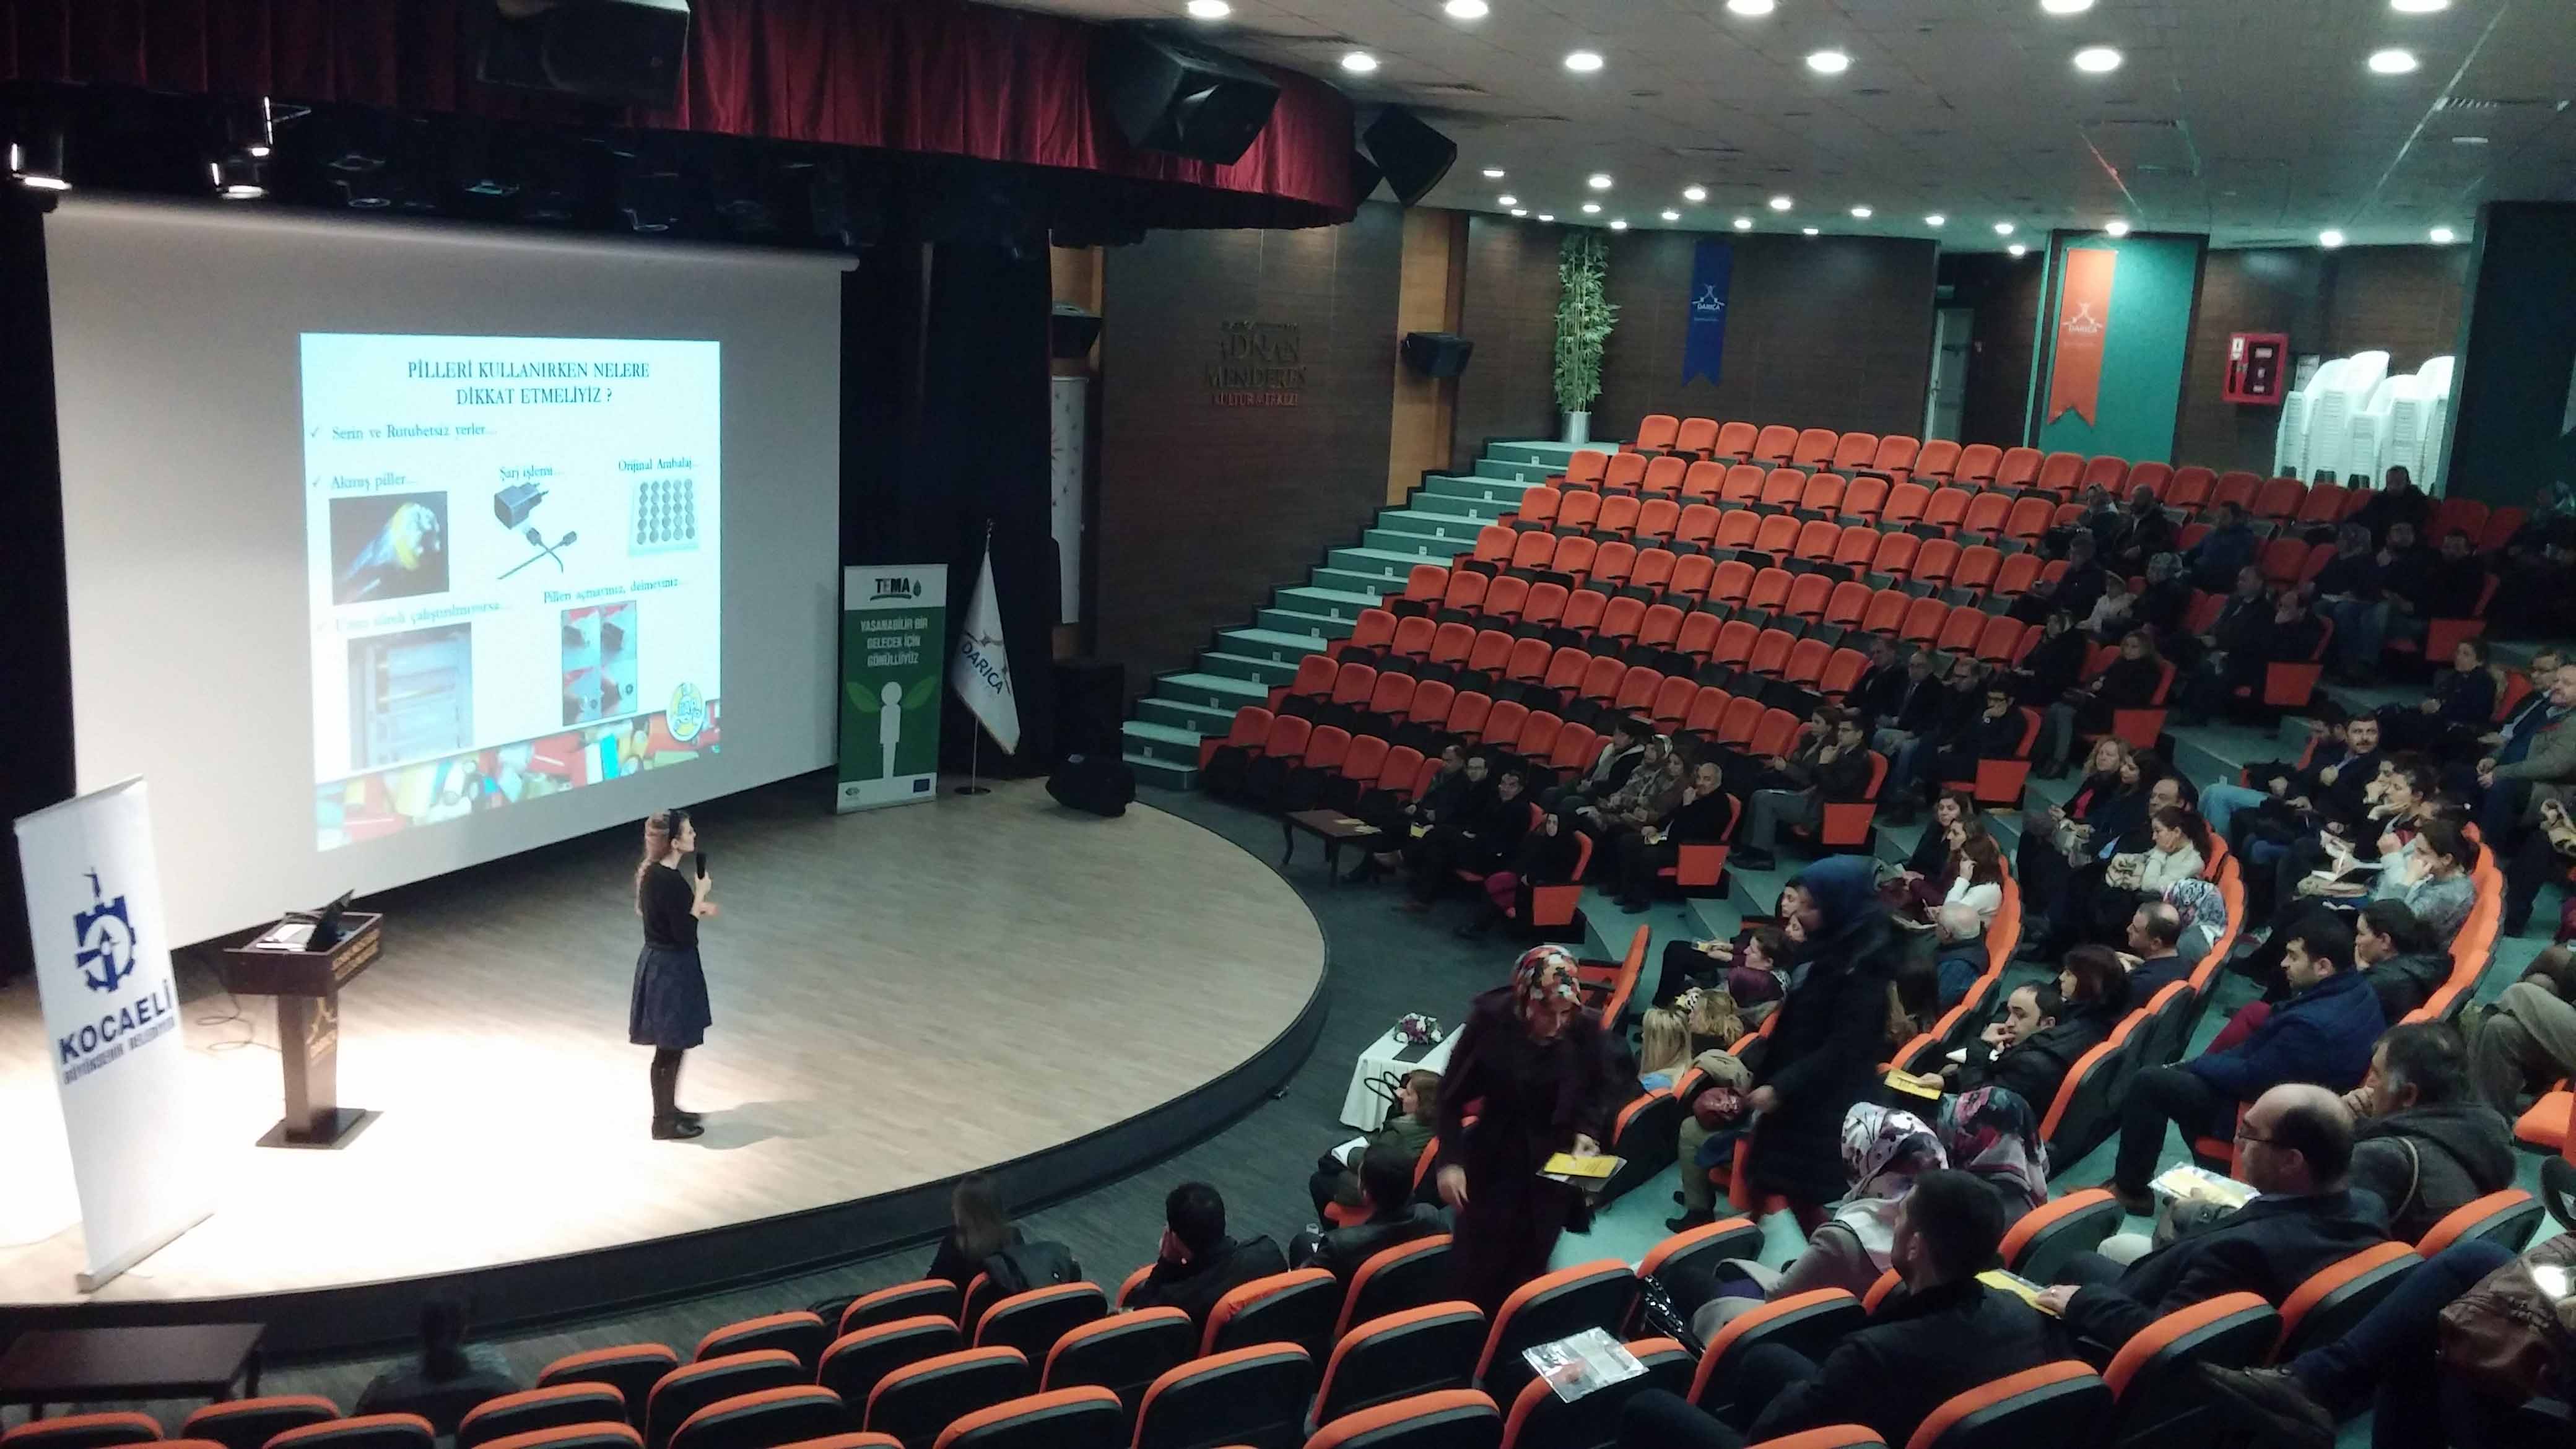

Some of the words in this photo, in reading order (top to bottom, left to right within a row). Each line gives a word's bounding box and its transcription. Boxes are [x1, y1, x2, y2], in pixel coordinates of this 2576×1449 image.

[408, 359, 472, 378] PİLLERİ
[479, 362, 588, 378] KULLANIRKEN
[594, 362, 650, 378] NELERE
[456, 386, 515, 405] DİKKAT
[521, 385, 601, 404] ETMELİYİZ
[606, 388, 612, 402] ?
[332, 426, 363, 440] Serin
[370, 429, 381, 438] ve
[874, 577, 910, 594] TEMA
[962, 642, 1004, 695] DARICA
[58, 979, 172, 1065] KOCAELİ
